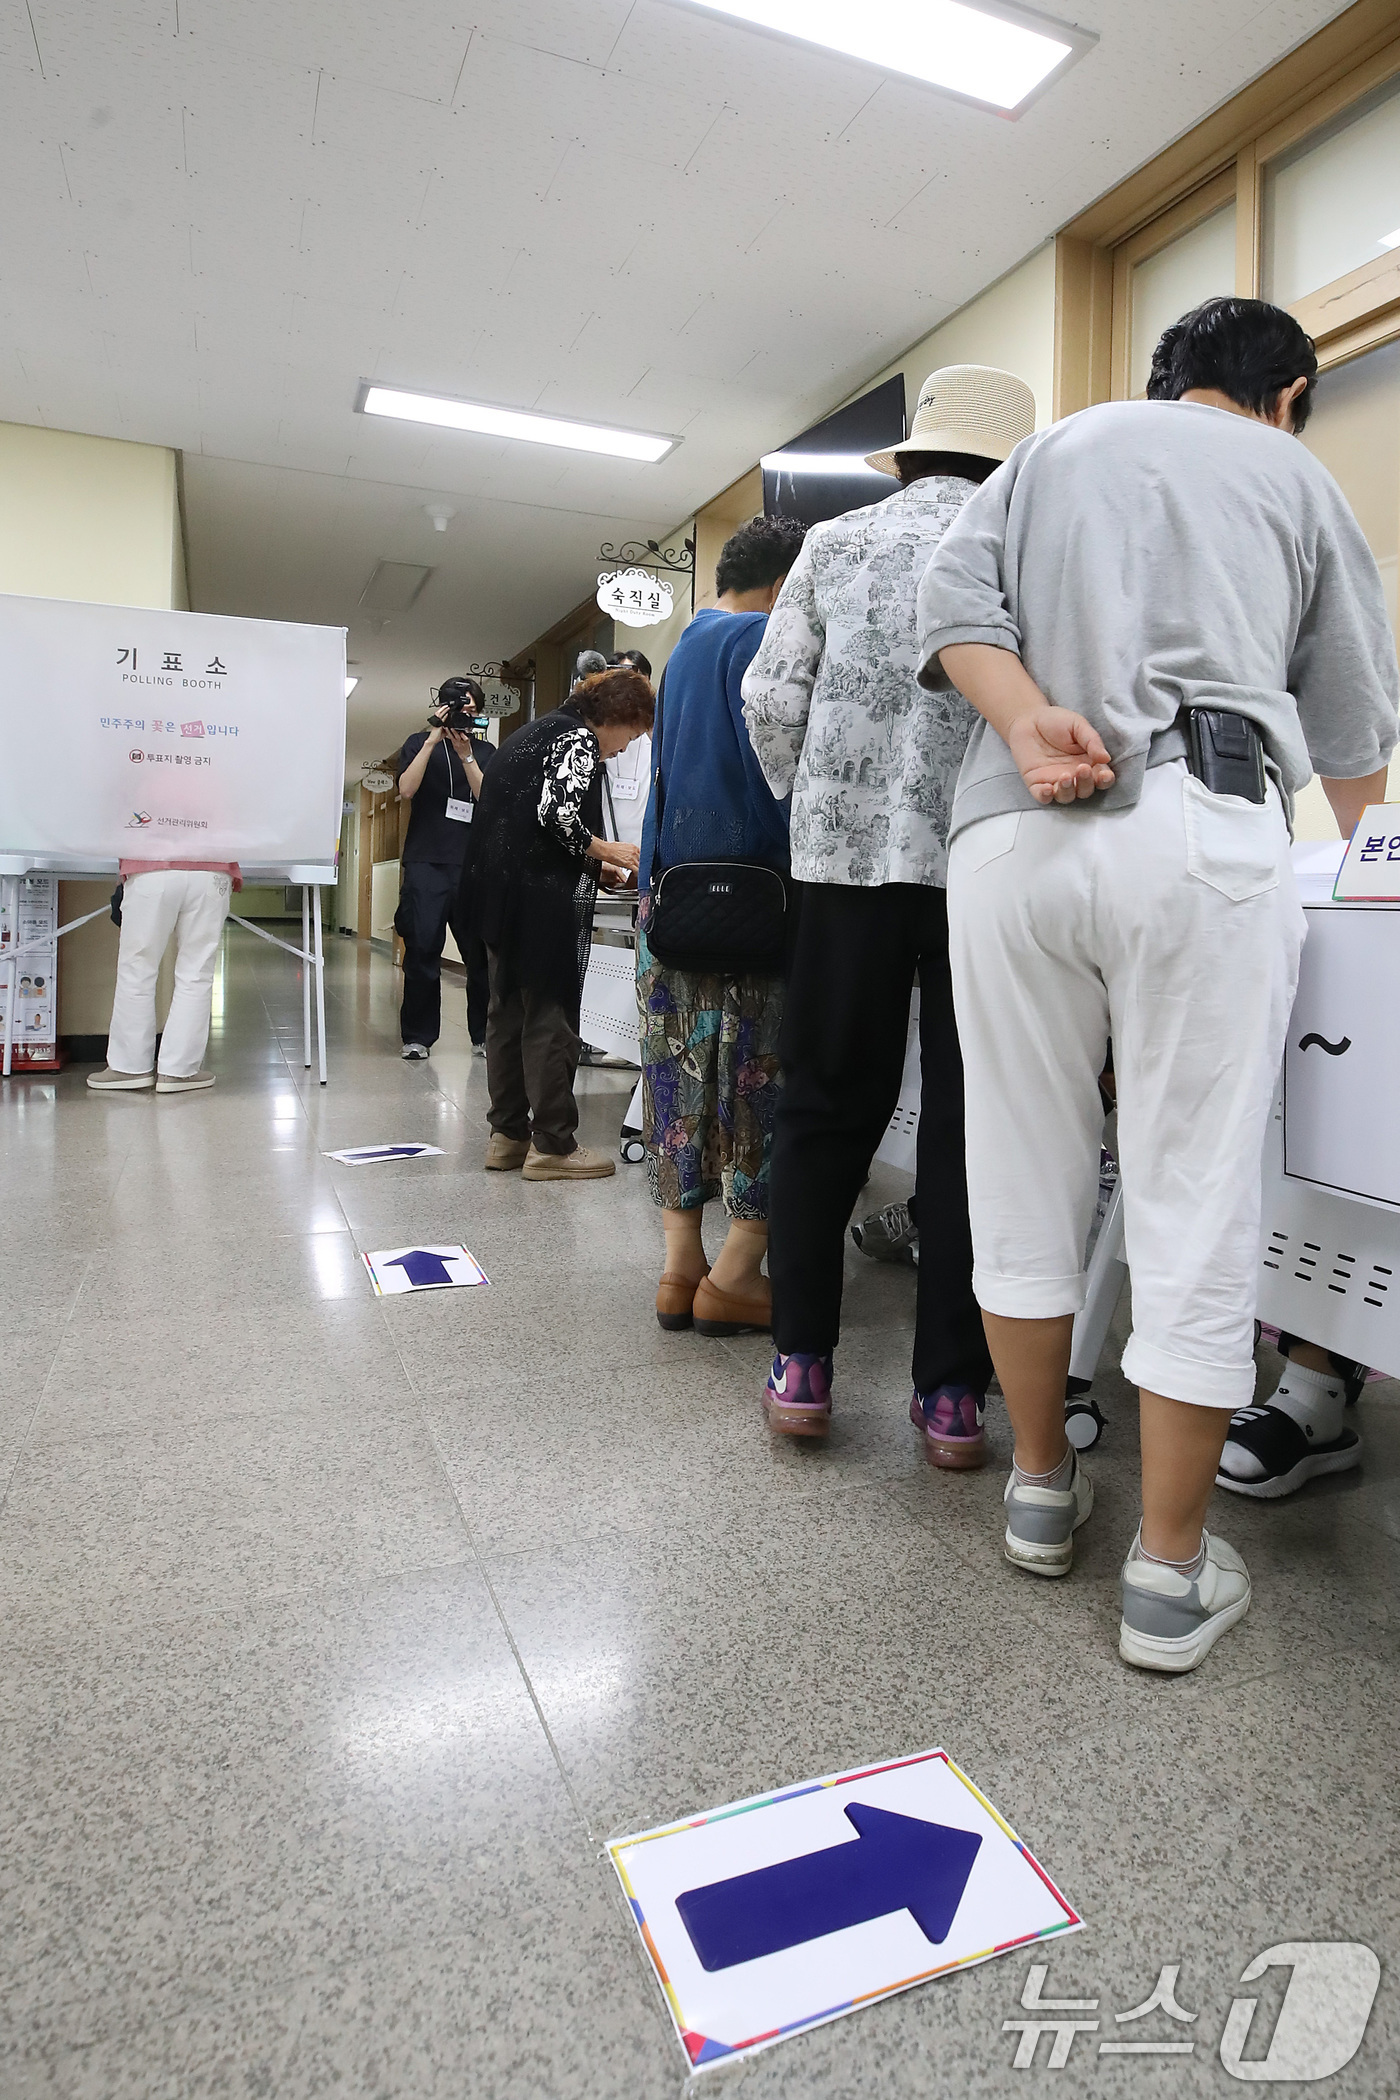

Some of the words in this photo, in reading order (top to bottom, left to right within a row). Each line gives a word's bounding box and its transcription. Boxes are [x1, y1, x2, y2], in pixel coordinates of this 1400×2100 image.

[611, 587, 660, 610] 숙직실
[122, 673, 173, 686] POLLING
[182, 678, 221, 690] BOOTH
[485, 693, 512, 706] 건실
[100, 717, 145, 731] 민주주의
[152, 719, 176, 733] 꽃은
[147, 753, 172, 763] 투표지
[174, 755, 192, 765] 촬영
[193, 756, 211, 766] 금지
[157, 817, 208, 829] 선거관리위원회
